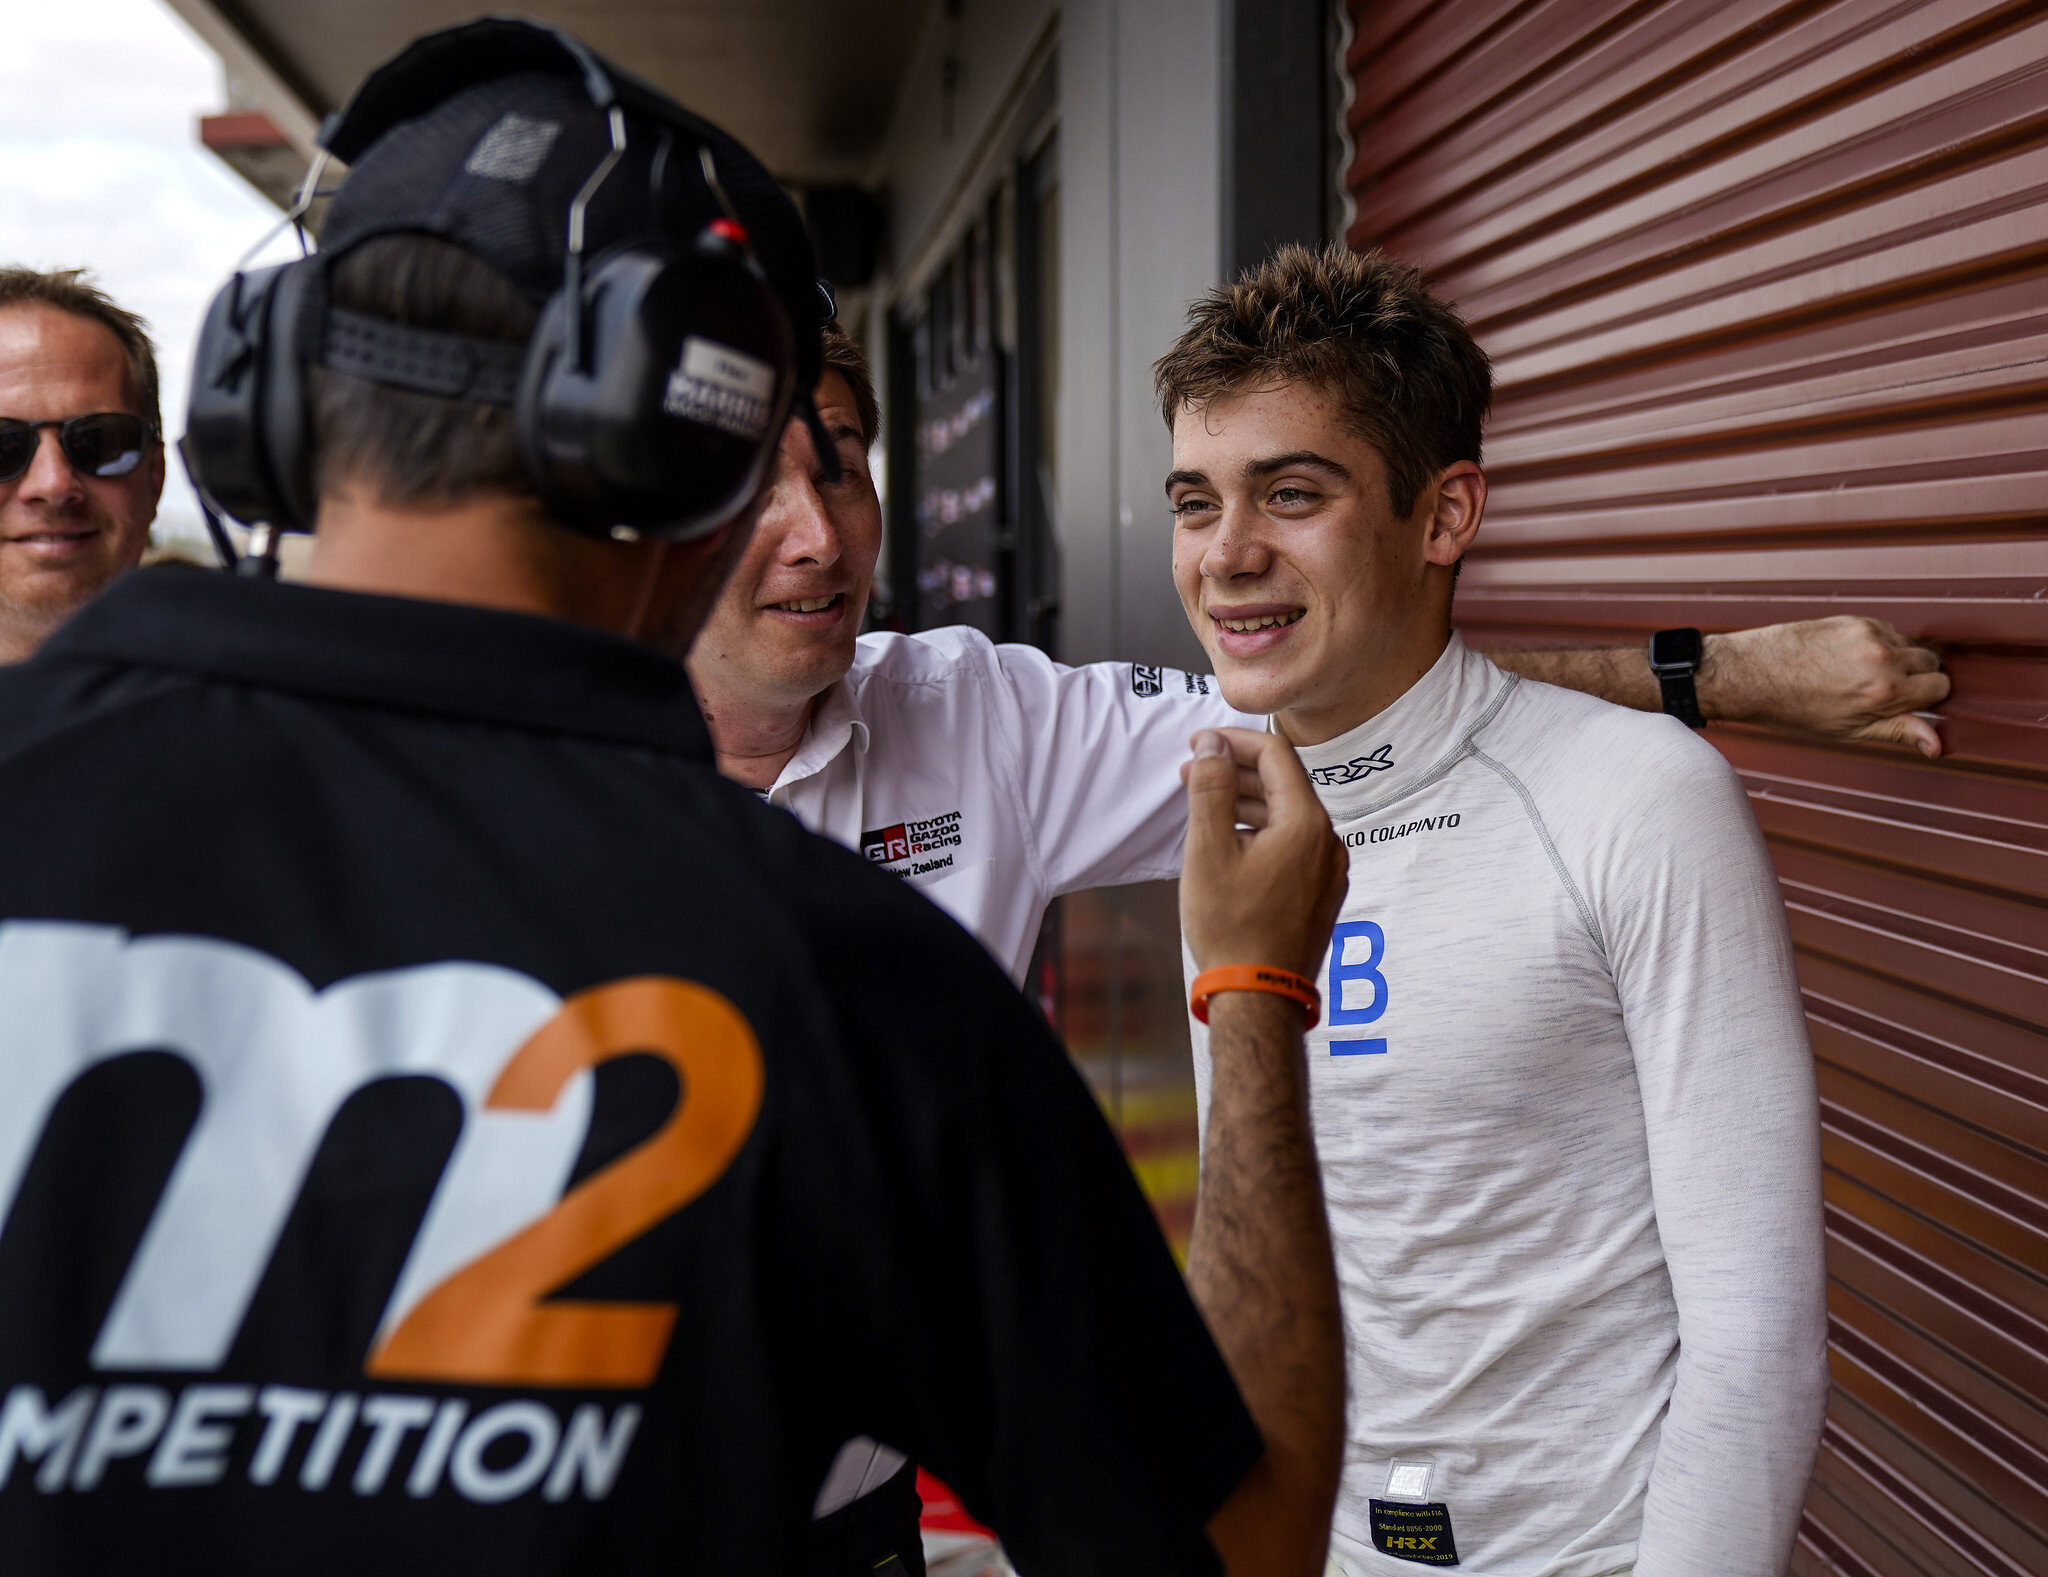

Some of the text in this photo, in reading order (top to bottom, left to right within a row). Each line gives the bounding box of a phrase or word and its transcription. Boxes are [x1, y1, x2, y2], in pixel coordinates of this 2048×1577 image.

[907, 811, 962, 833] TOYOTA
[1342, 813, 1461, 848] CO COLAPINTO
[910, 823, 960, 843] GAZOO
[864, 838, 908, 862] GR
[911, 834, 962, 854] Racing
[912, 854, 954, 875] Zealand
[1328, 920, 1388, 1026] B
[0, 1382, 642, 1501] MPETITION
[1415, 1510, 1431, 1518] with
[1379, 1523, 1405, 1532] Standard
[1387, 1536, 1438, 1549] HRX
